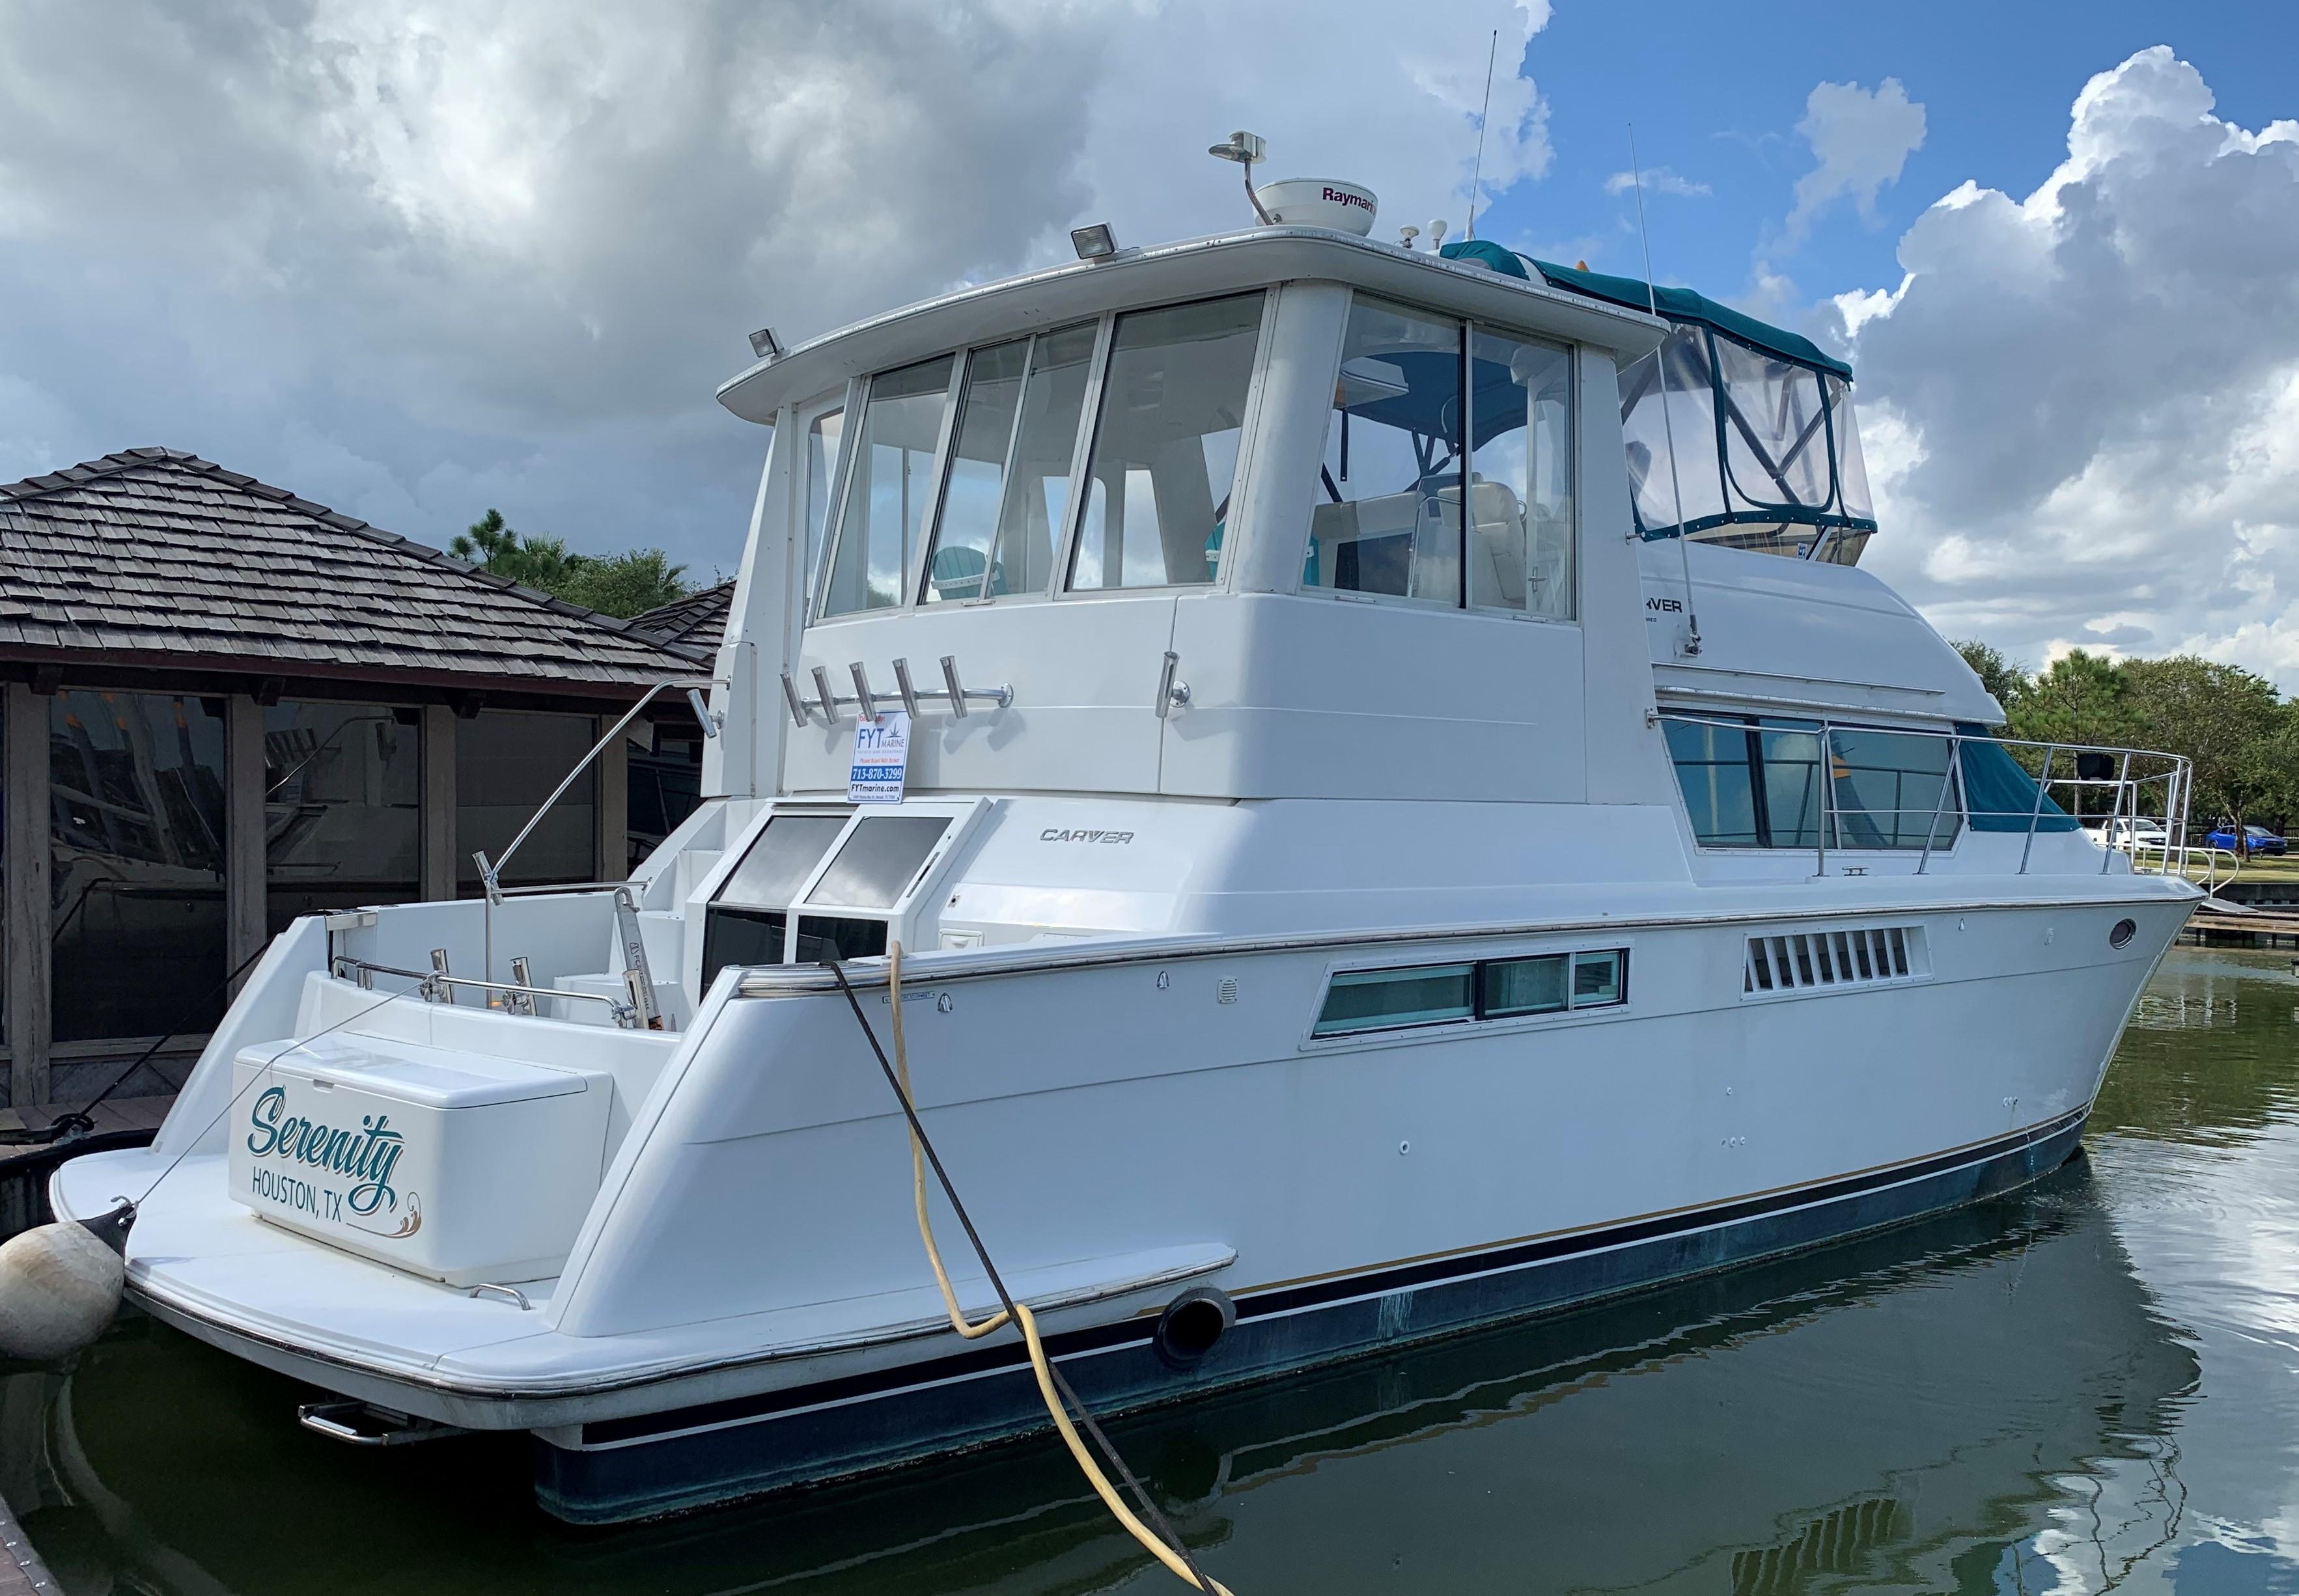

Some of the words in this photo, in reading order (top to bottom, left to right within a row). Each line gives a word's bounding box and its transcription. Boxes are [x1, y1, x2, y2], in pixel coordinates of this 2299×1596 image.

[858, 728, 884, 749] FYT
[881, 739, 905, 748] MARINE
[853, 768, 902, 780] 713-870-3299
[851, 784, 899, 792] FYTmarine.com
[1040, 829, 1134, 844] CARVER
[247, 1084, 405, 1216] Serenity
[253, 1166, 320, 1220] HOUSTON,
[324, 1190, 342, 1222] TX
